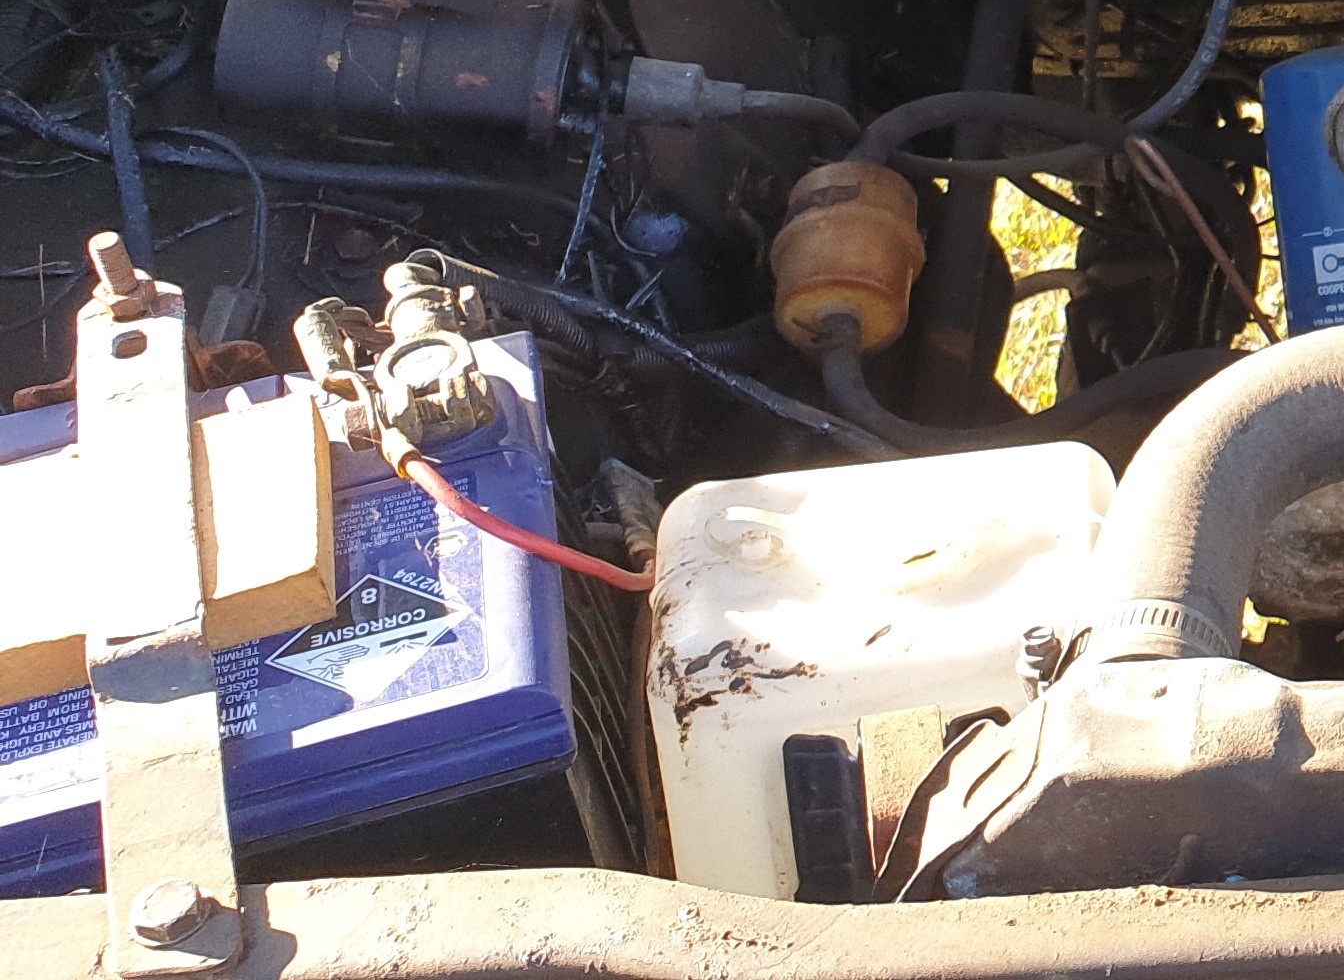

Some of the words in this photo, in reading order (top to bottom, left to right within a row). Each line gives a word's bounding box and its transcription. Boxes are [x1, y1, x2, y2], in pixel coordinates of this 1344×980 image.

[361, 588, 377, 604] 8
[310, 608, 426, 647] CORROSIVE
[214, 656, 259, 674] METAL
[218, 677, 258, 695] GASES
[29, 699, 47, 711] OR
[225, 688, 258, 705] LEAD
[48, 700, 88, 717] FROM
[33, 728, 63, 742] AND
